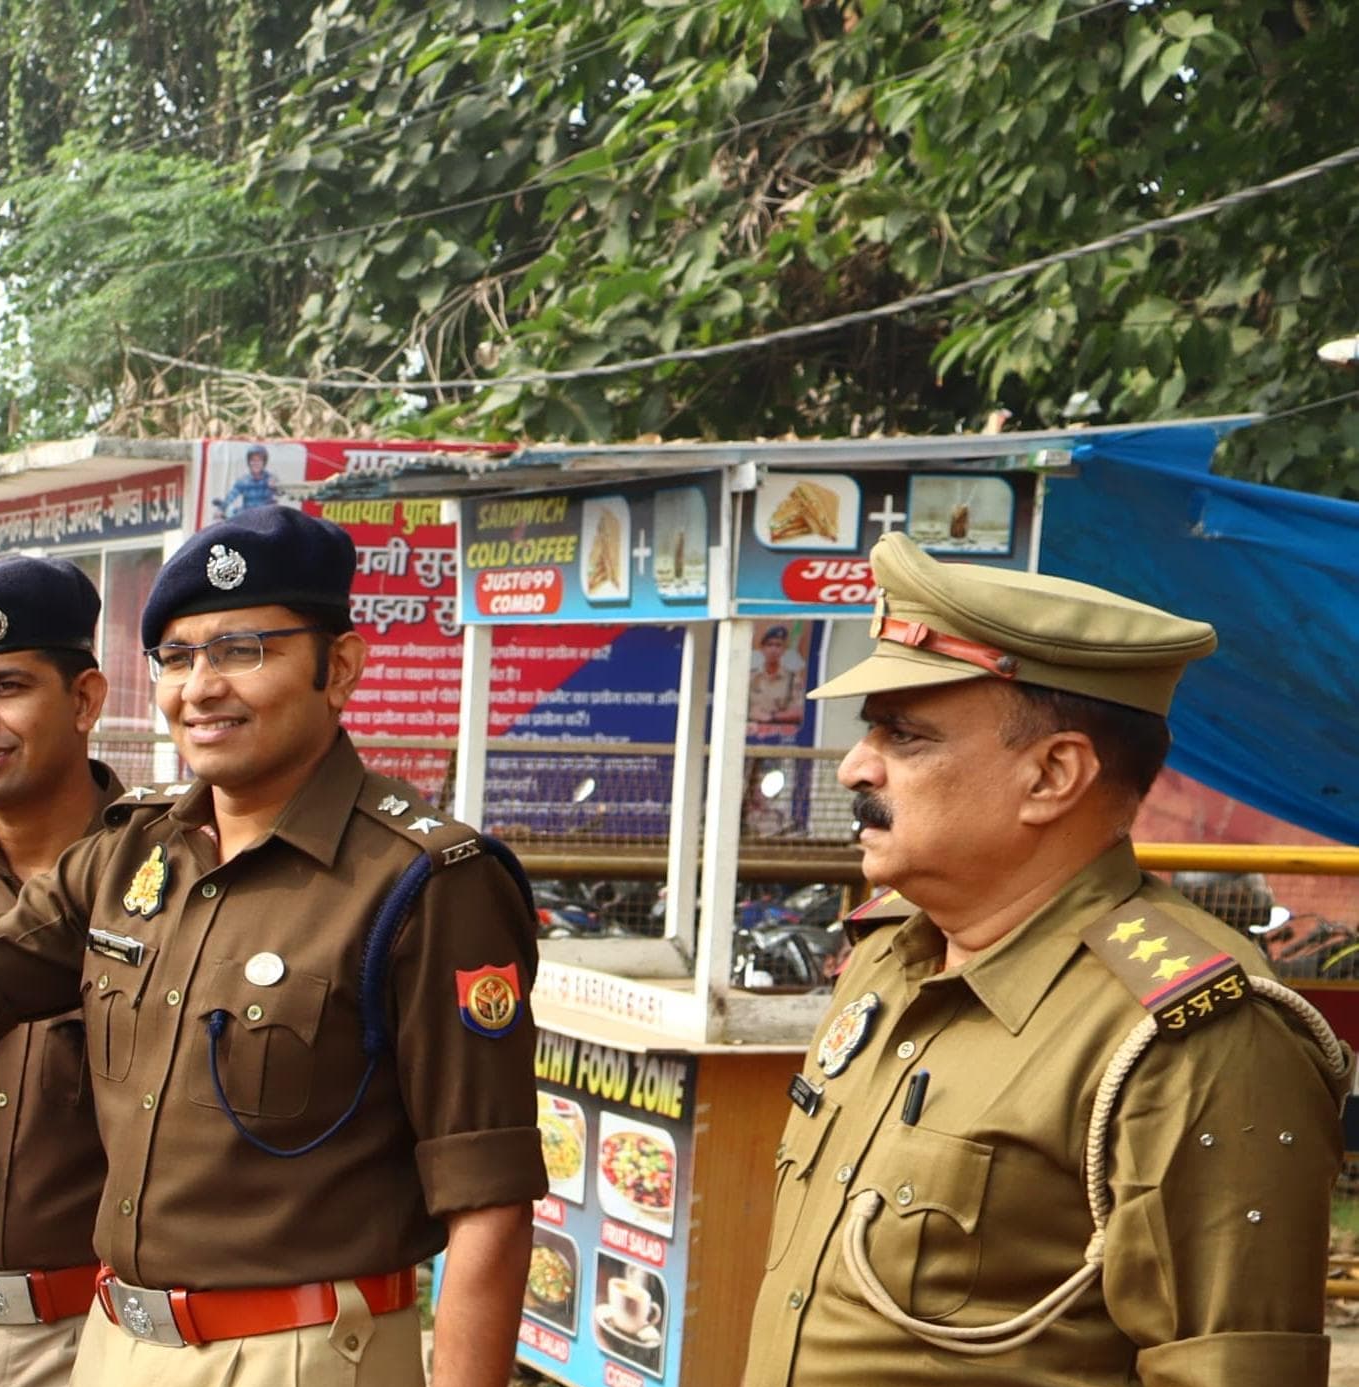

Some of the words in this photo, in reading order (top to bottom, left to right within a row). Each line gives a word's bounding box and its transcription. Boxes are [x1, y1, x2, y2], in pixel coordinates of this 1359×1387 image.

[477, 498, 567, 529] SANDWICH
[354, 537, 412, 576] पनी
[467, 541, 510, 568] COLD
[511, 534, 579, 565] COFFEE
[482, 569, 555, 592] JUST@99
[801, 560, 880, 580] JUS
[349, 594, 432, 634] सड़क
[433, 596, 464, 637] सु
[490, 593, 546, 613] COMBO
[576, 1041, 629, 1102] FOOD
[630, 1052, 687, 1121] ZONE
